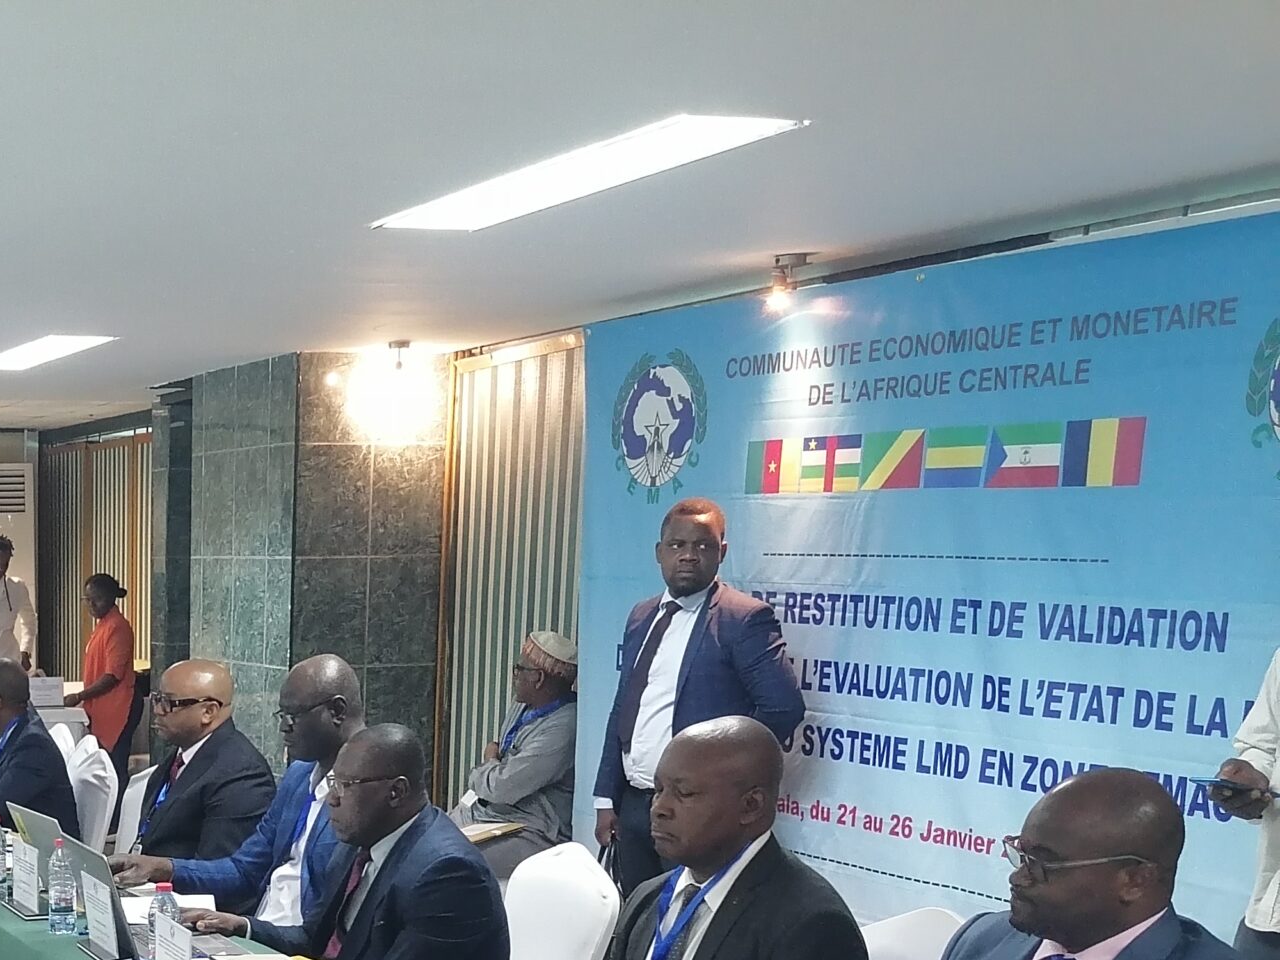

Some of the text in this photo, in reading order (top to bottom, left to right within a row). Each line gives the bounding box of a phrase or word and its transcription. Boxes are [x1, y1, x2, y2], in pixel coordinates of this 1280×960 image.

[725, 296, 1239, 379] COMMUNAUTE ECONOMIQUE ET MONETAIRE
[808, 358, 1092, 407] DE L'AFRIQUE CENTRALE
[783, 591, 942, 633] RESTITUTION
[949, 598, 983, 635] ET
[987, 600, 1028, 639] DE
[1038, 602, 1230, 653] VALIDATION
[801, 658, 974, 708] L'EVALUATION
[980, 674, 1012, 713] DE
[1018, 678, 1125, 725] L'ETAT
[1132, 689, 1177, 732] DE
[1185, 694, 1229, 739] LA
[801, 724, 909, 771] SYSTEME
[915, 739, 970, 780] LMD
[978, 748, 1014, 788] EN
[809, 799, 831, 823] du
[836, 803, 857, 828] 21
[862, 814, 883, 834] au
[888, 814, 913, 839] 26
[919, 820, 996, 855] Janvier
